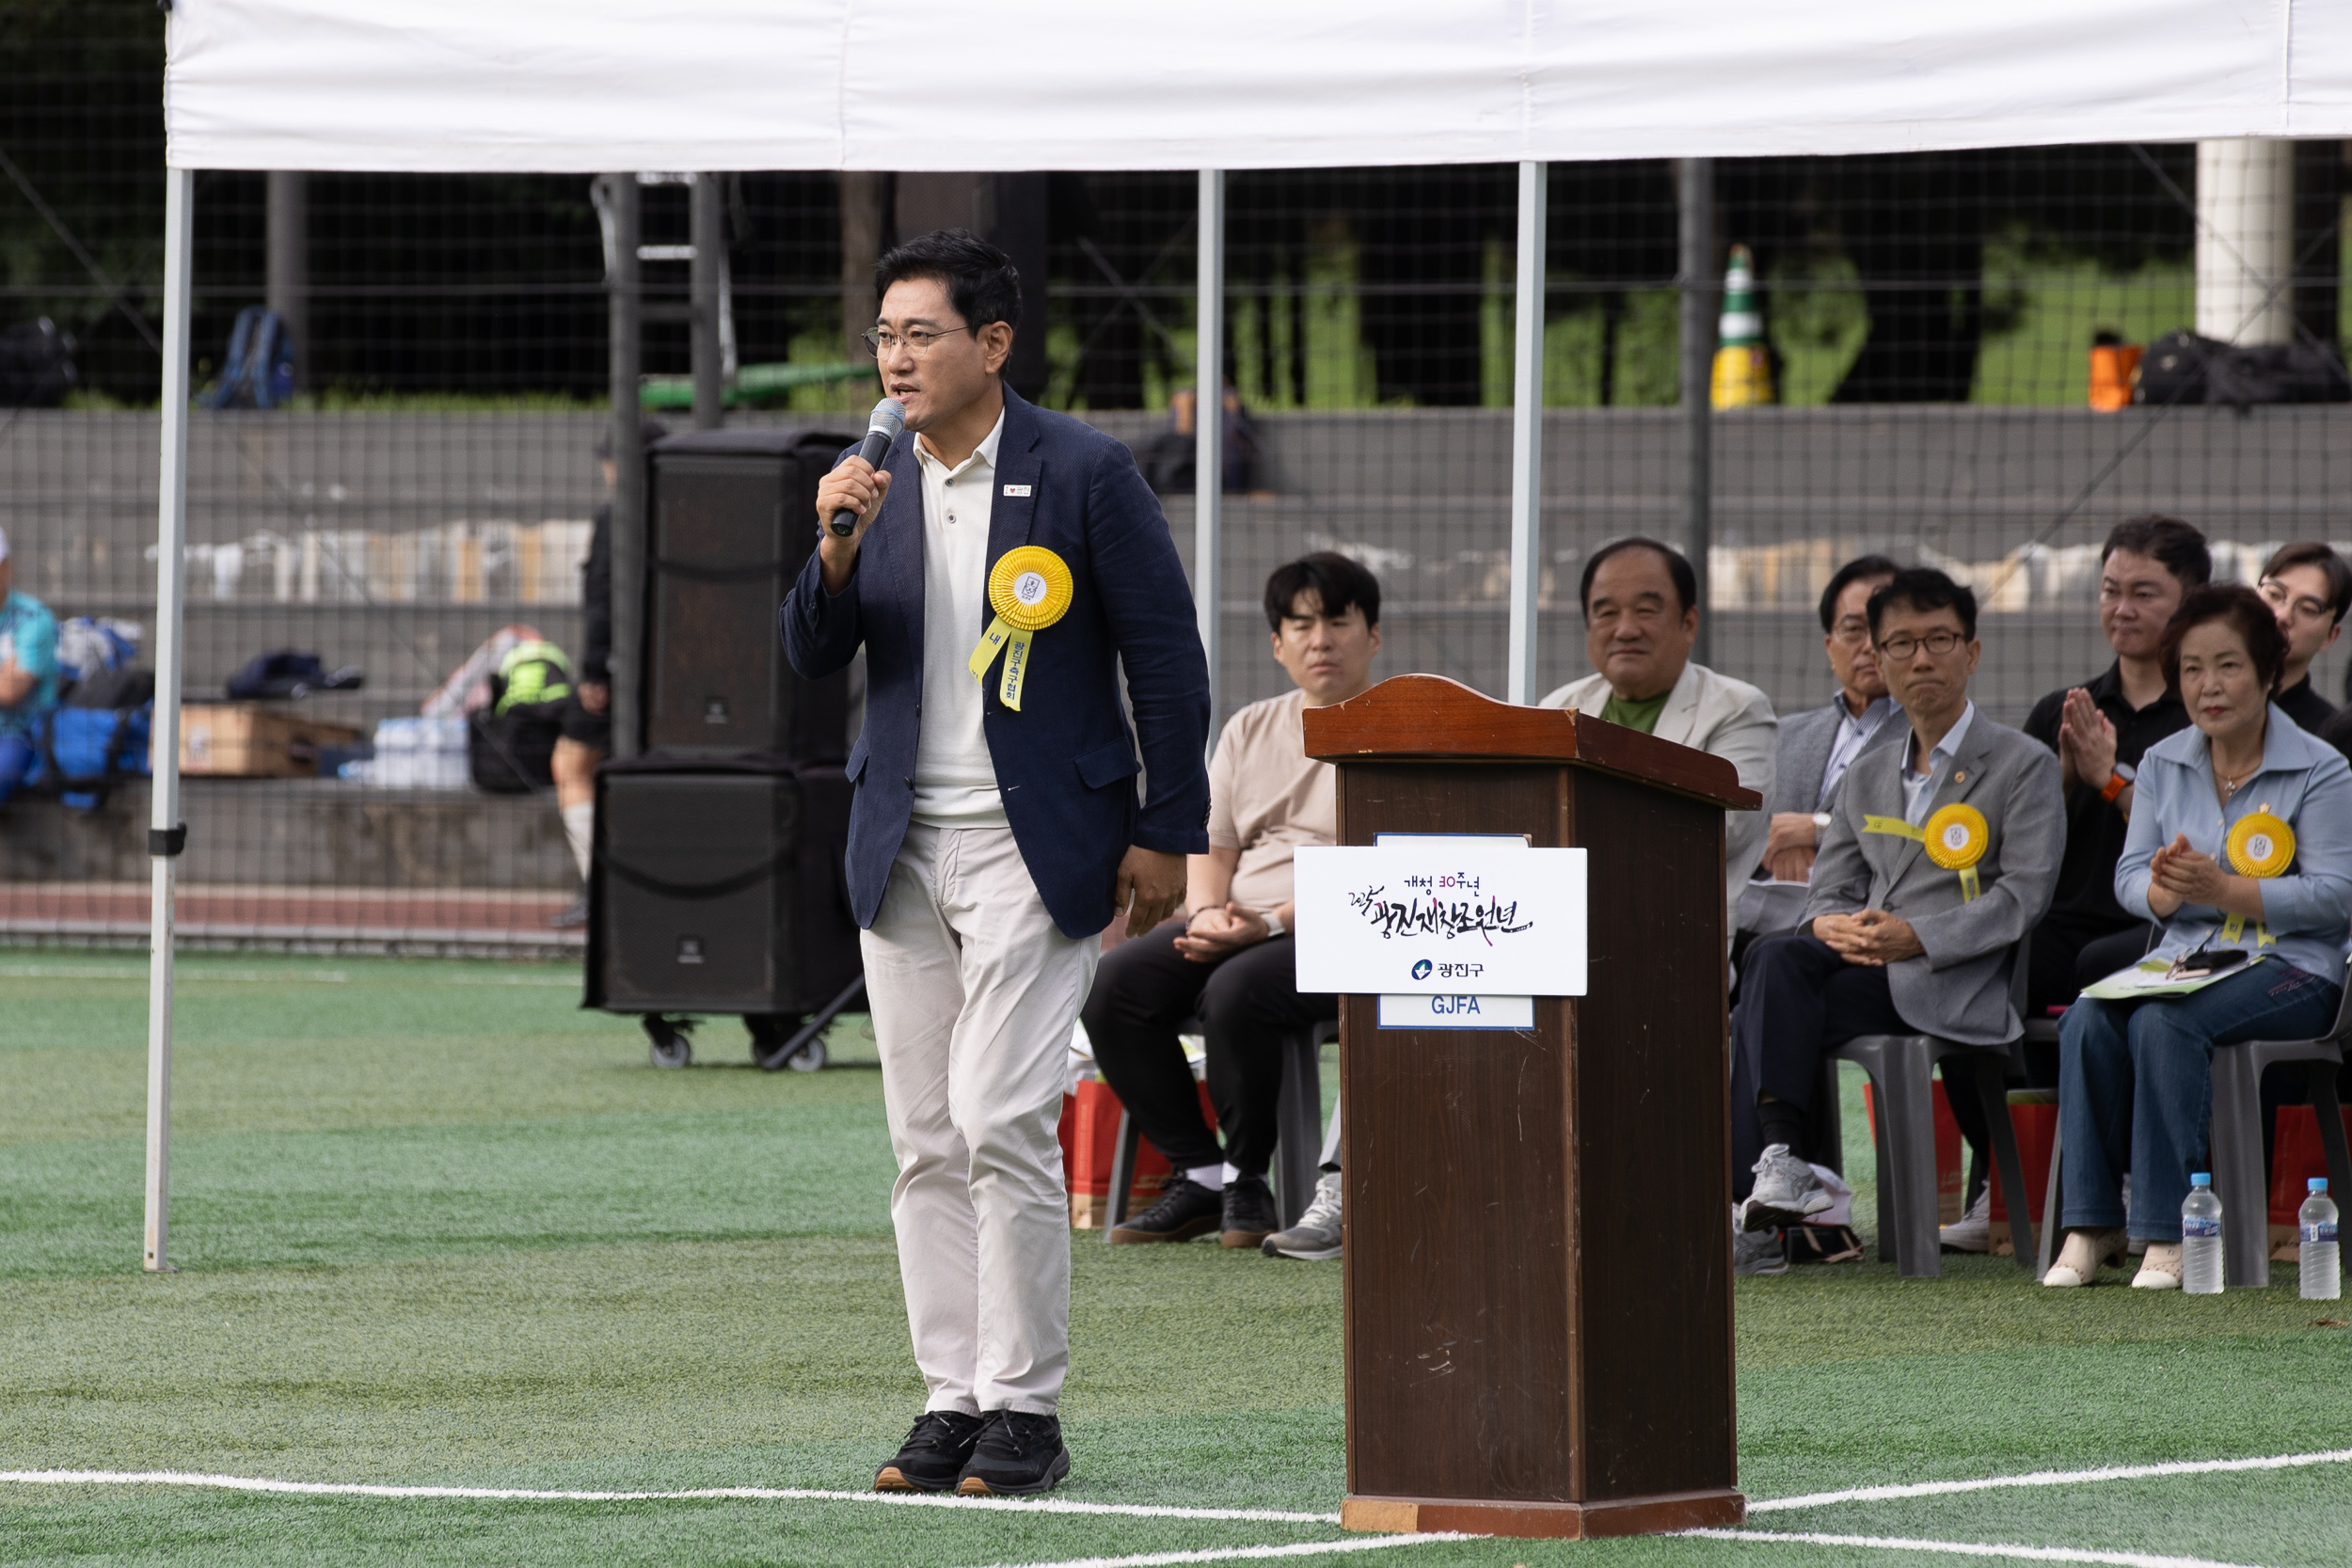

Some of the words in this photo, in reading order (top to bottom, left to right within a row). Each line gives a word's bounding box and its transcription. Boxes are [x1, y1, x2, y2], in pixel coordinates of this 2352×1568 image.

[1005, 641, 1025, 701] 광진구축구협회
[1404, 876, 1433, 895] 개청
[1438, 872, 1480, 896] 30주년
[1438, 963, 1485, 978] 광진구
[1432, 996, 1481, 1015] GJFA
